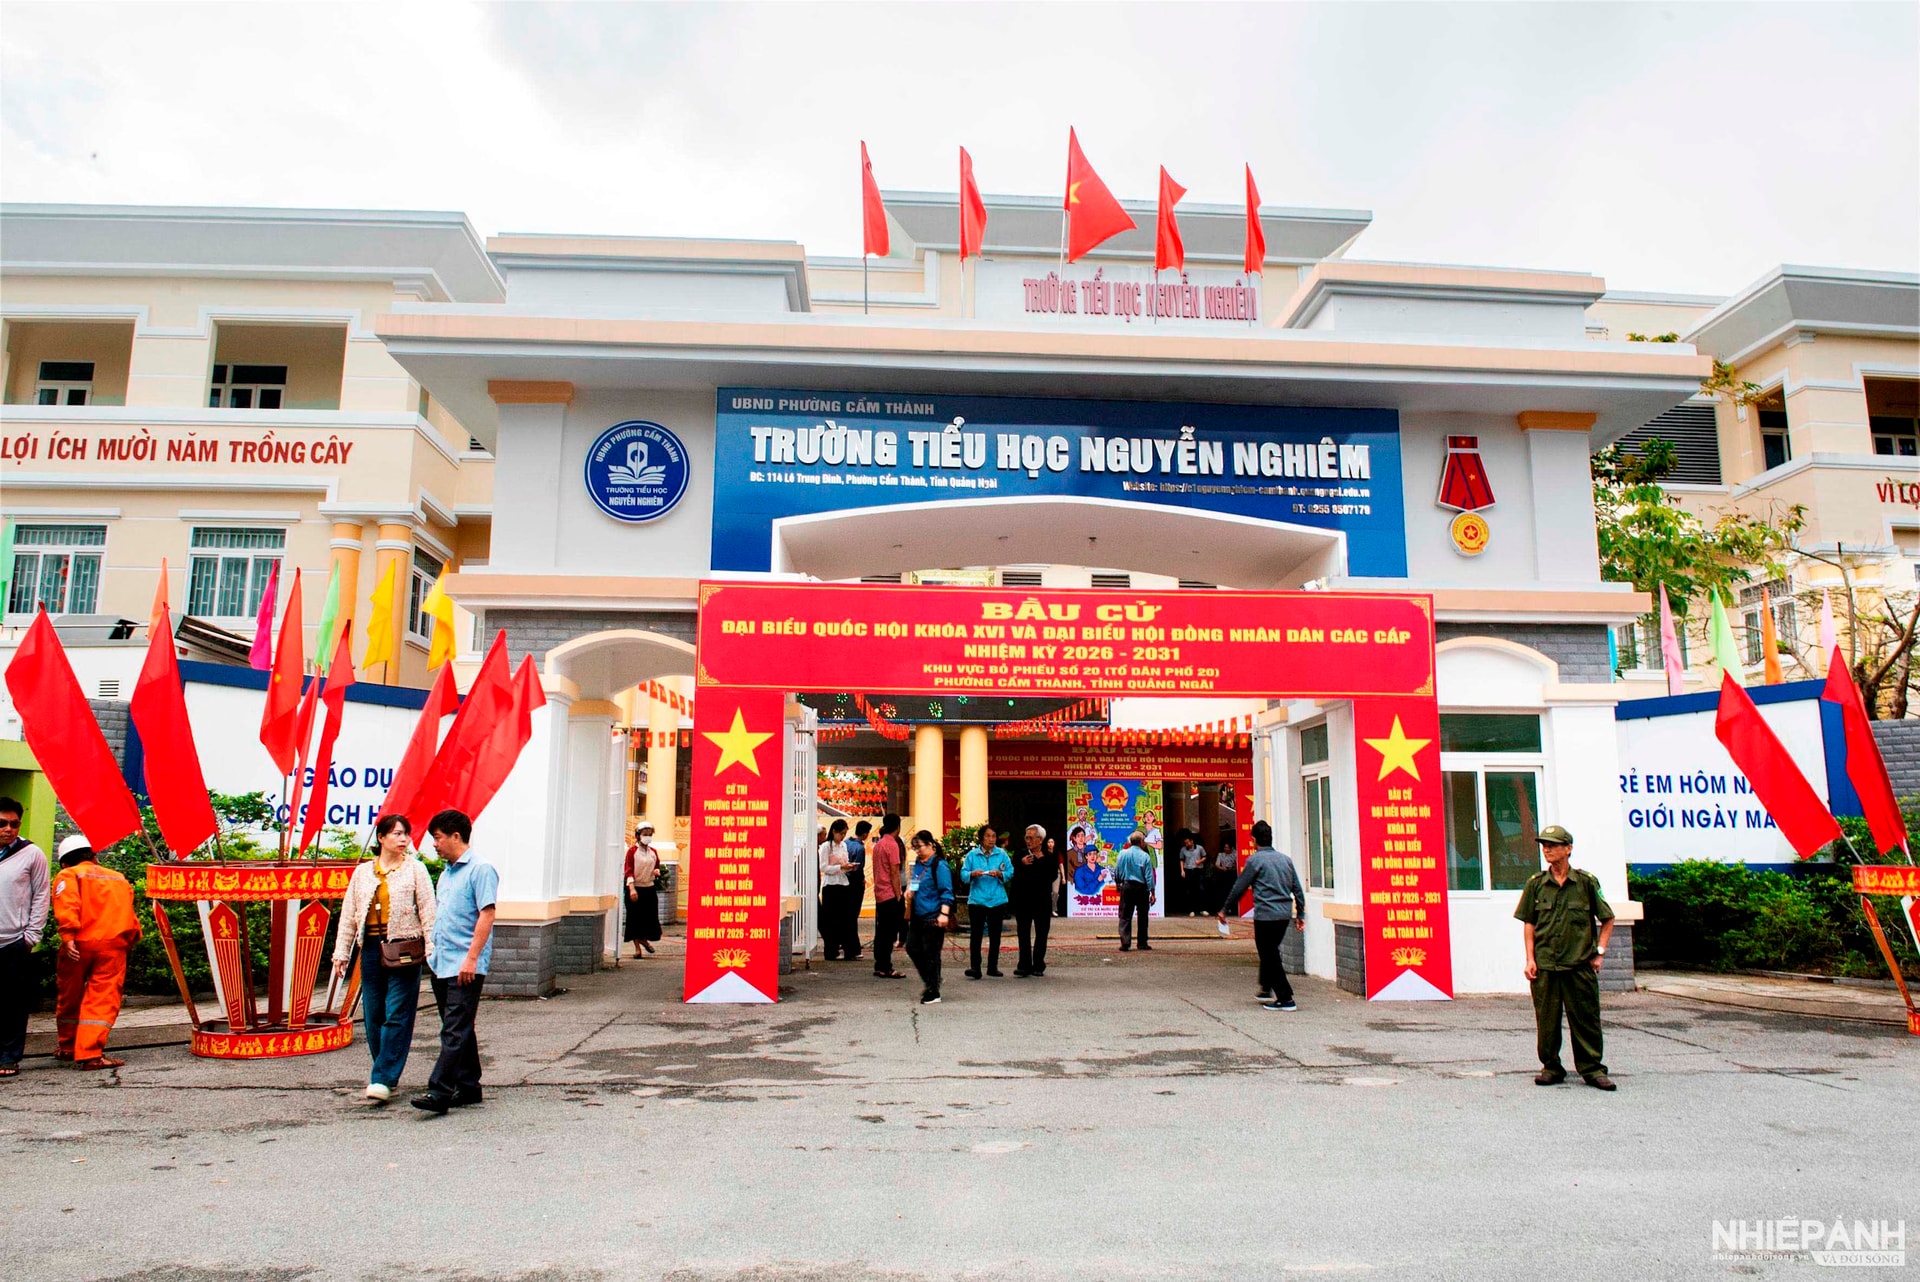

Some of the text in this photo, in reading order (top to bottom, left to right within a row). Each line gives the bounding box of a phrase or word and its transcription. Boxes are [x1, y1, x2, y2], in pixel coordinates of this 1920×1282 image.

[1023, 266, 1256, 322] TRƯỜNG TIỂU HỌC NGUYỄN NGHIÊM
[732, 396, 934, 415] UBND PHƯỜNG CẨM THÀNH
[1, 428, 354, 465] LỢI ÍCH MƯỜI NĂM TRỒNG CÂY
[595, 441, 612, 463] UBND
[751, 416, 1371, 479] TRƯỜNG TIỂU HỌC NGUYỄN NGHIÊM
[606, 485, 668, 495] TRƯỜNG TIỂU HỌC
[750, 472, 765, 482] ĐC:
[767, 473, 783, 483] 114
[796, 473, 820, 485] Trung
[845, 474, 878, 486] Phường
[879, 473, 898, 486] Cẩm
[899, 475, 928, 488] Thành,
[930, 474, 948, 487] Tỉnh
[950, 476, 977, 489] Quảng
[1123, 481, 1157, 492] Website:
[609, 494, 664, 506] NGUYỄN NGHIÊM
[1876, 476, 1920, 510] VÌ LỢ
[981, 597, 1162, 622] BẦU CỬ
[721, 617, 1411, 644] ĐẠI BIỂU QUỐC HỘI KHÓA XVI VÀ ĐẠI BIỂU HỘI ĐỒNG NHÂN DÂN CÁC CẤP
[964, 643, 1026, 660] NHIỆM
[1032, 644, 1057, 660] KỲ
[1063, 646, 1114, 660] 2026
[1133, 646, 1180, 661] 2031
[923, 663, 1220, 678] KHU VỰC BỎ PHIẾU SỐ 20 (TỔ DÂN PHỐ 20)
[934, 676, 993, 687] PHƯỜNG
[998, 676, 1031, 687] CẨM
[1091, 677, 1122, 688] TỈNH
[1127, 679, 1176, 690] QUẢNG
[1180, 680, 1214, 690] NGÃI
[364, 767, 393, 793] DỤ
[1619, 767, 1639, 793] RẺ
[1646, 775, 1672, 794] EM
[1680, 770, 1726, 794] HÔM
[1629, 802, 1776, 828] GIỚI NGÀY MA
